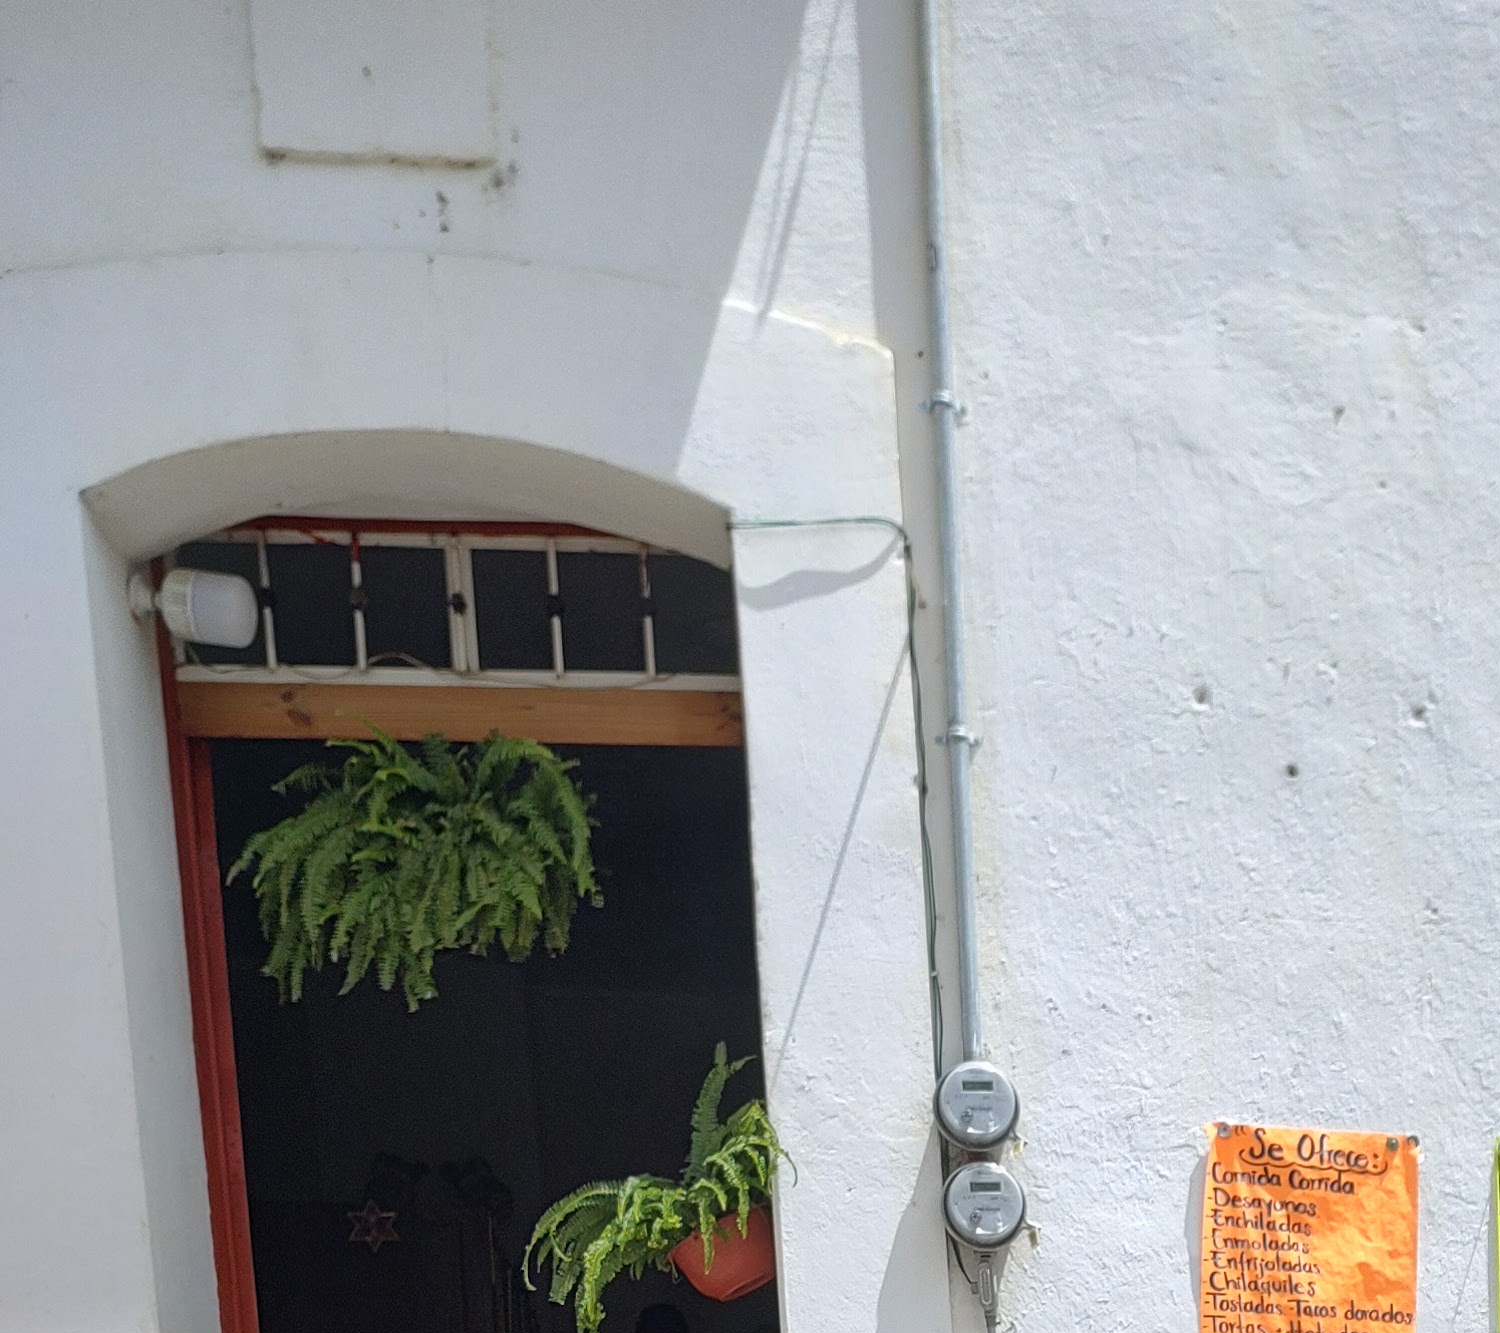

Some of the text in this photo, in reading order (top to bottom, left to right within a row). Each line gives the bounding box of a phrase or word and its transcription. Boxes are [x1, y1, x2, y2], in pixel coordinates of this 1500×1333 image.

[1211, 1161, 1356, 1195] Comida Corrida
[1344, 1300, 1413, 1325] dorados
